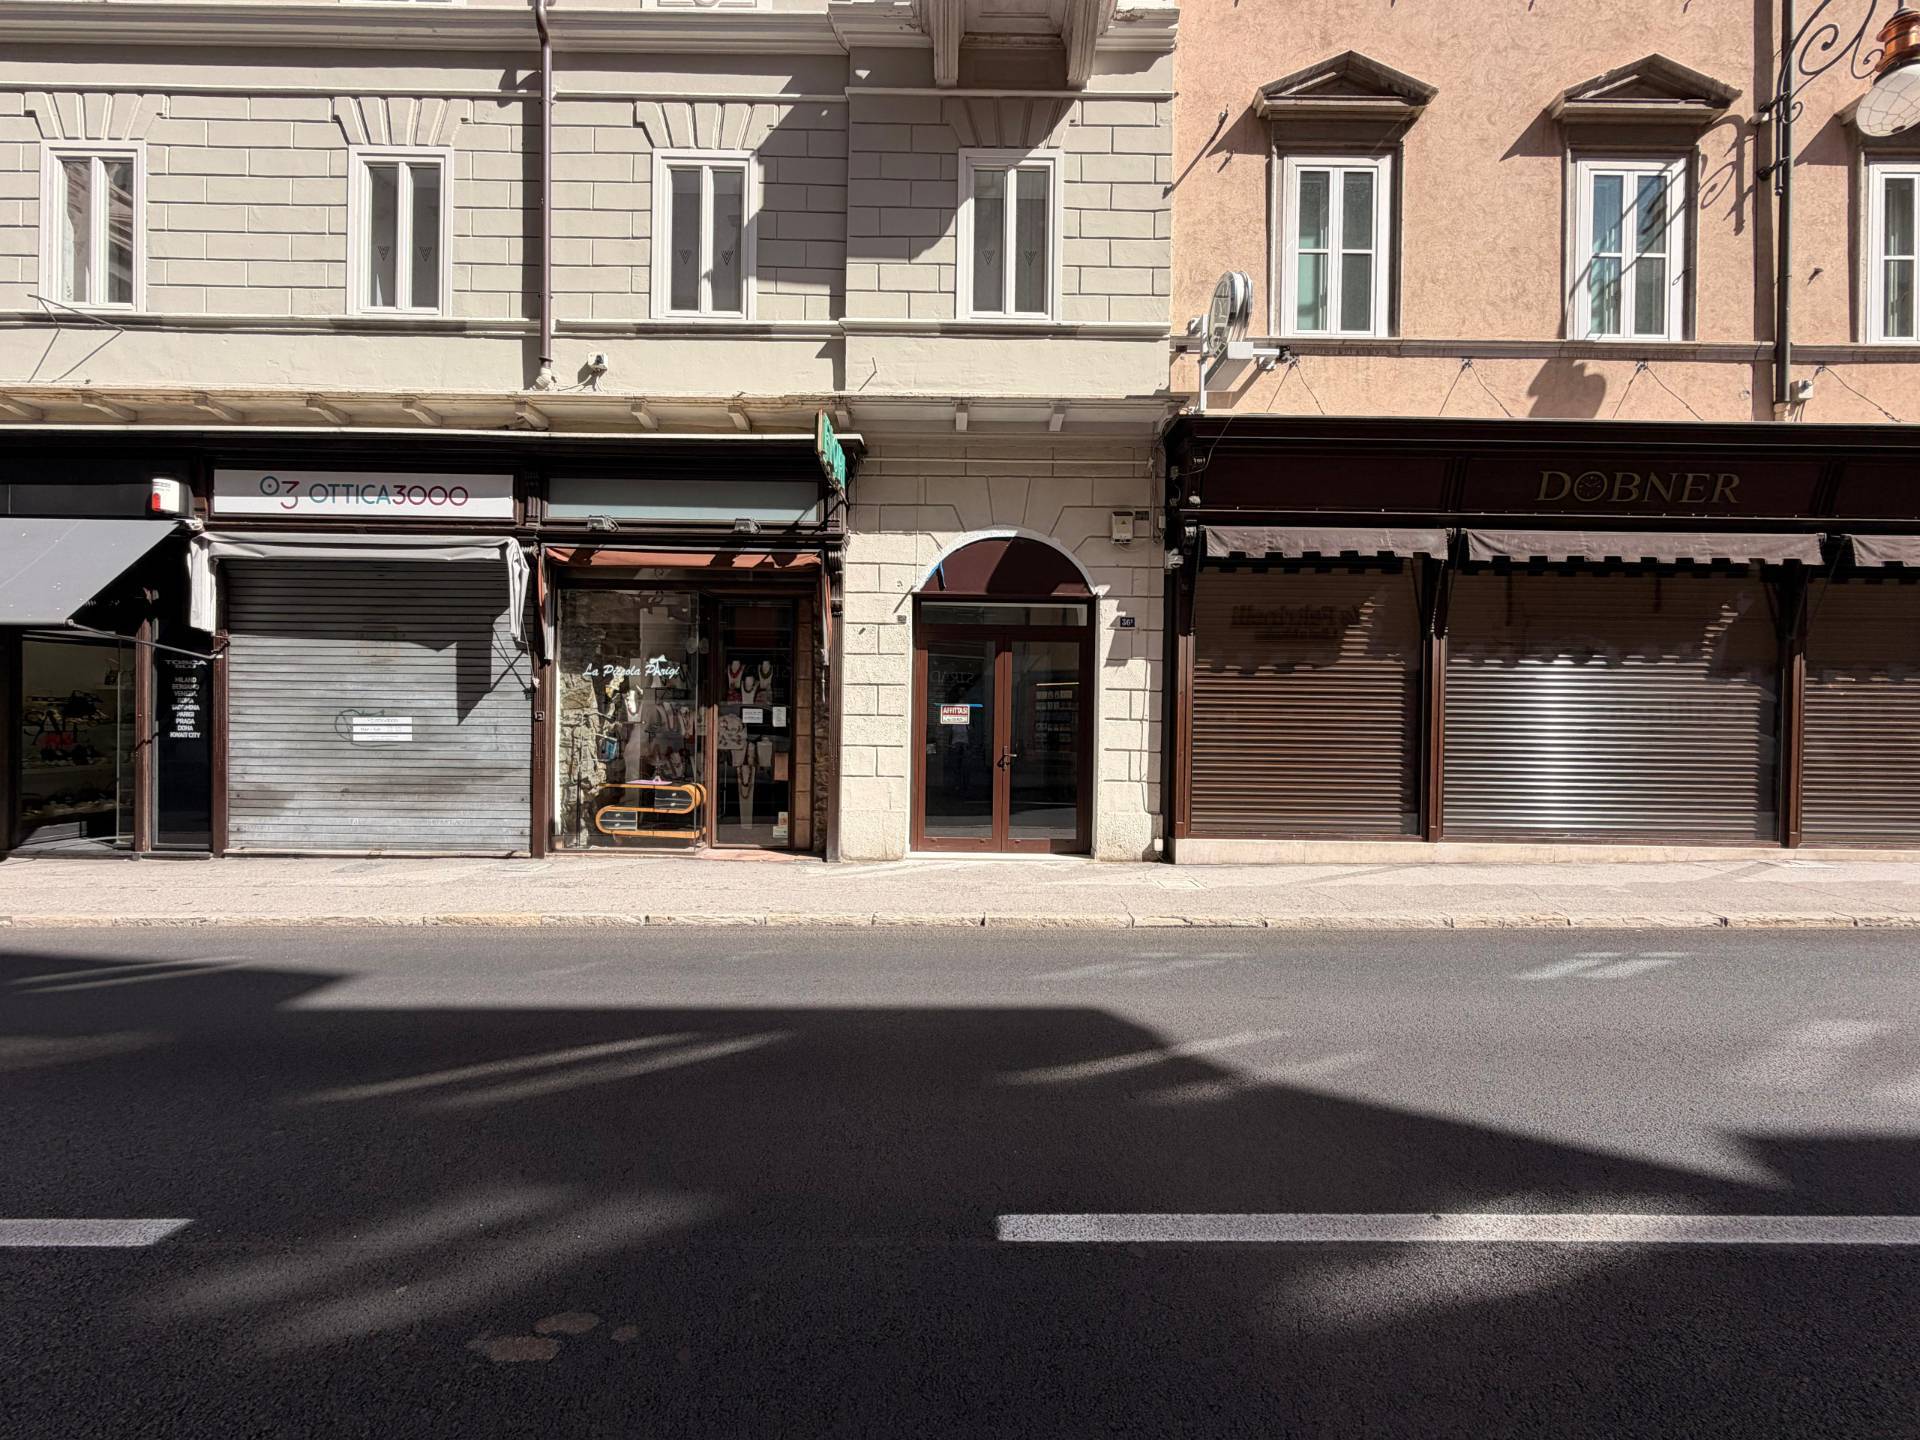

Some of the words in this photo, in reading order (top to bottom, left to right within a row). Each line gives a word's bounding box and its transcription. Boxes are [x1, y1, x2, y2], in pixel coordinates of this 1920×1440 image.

[309, 483, 469, 506] OTTICA3000
[1535, 470, 1741, 503] DOBNER
[583, 663, 599, 677] La
[603, 664, 641, 678] Piccola
